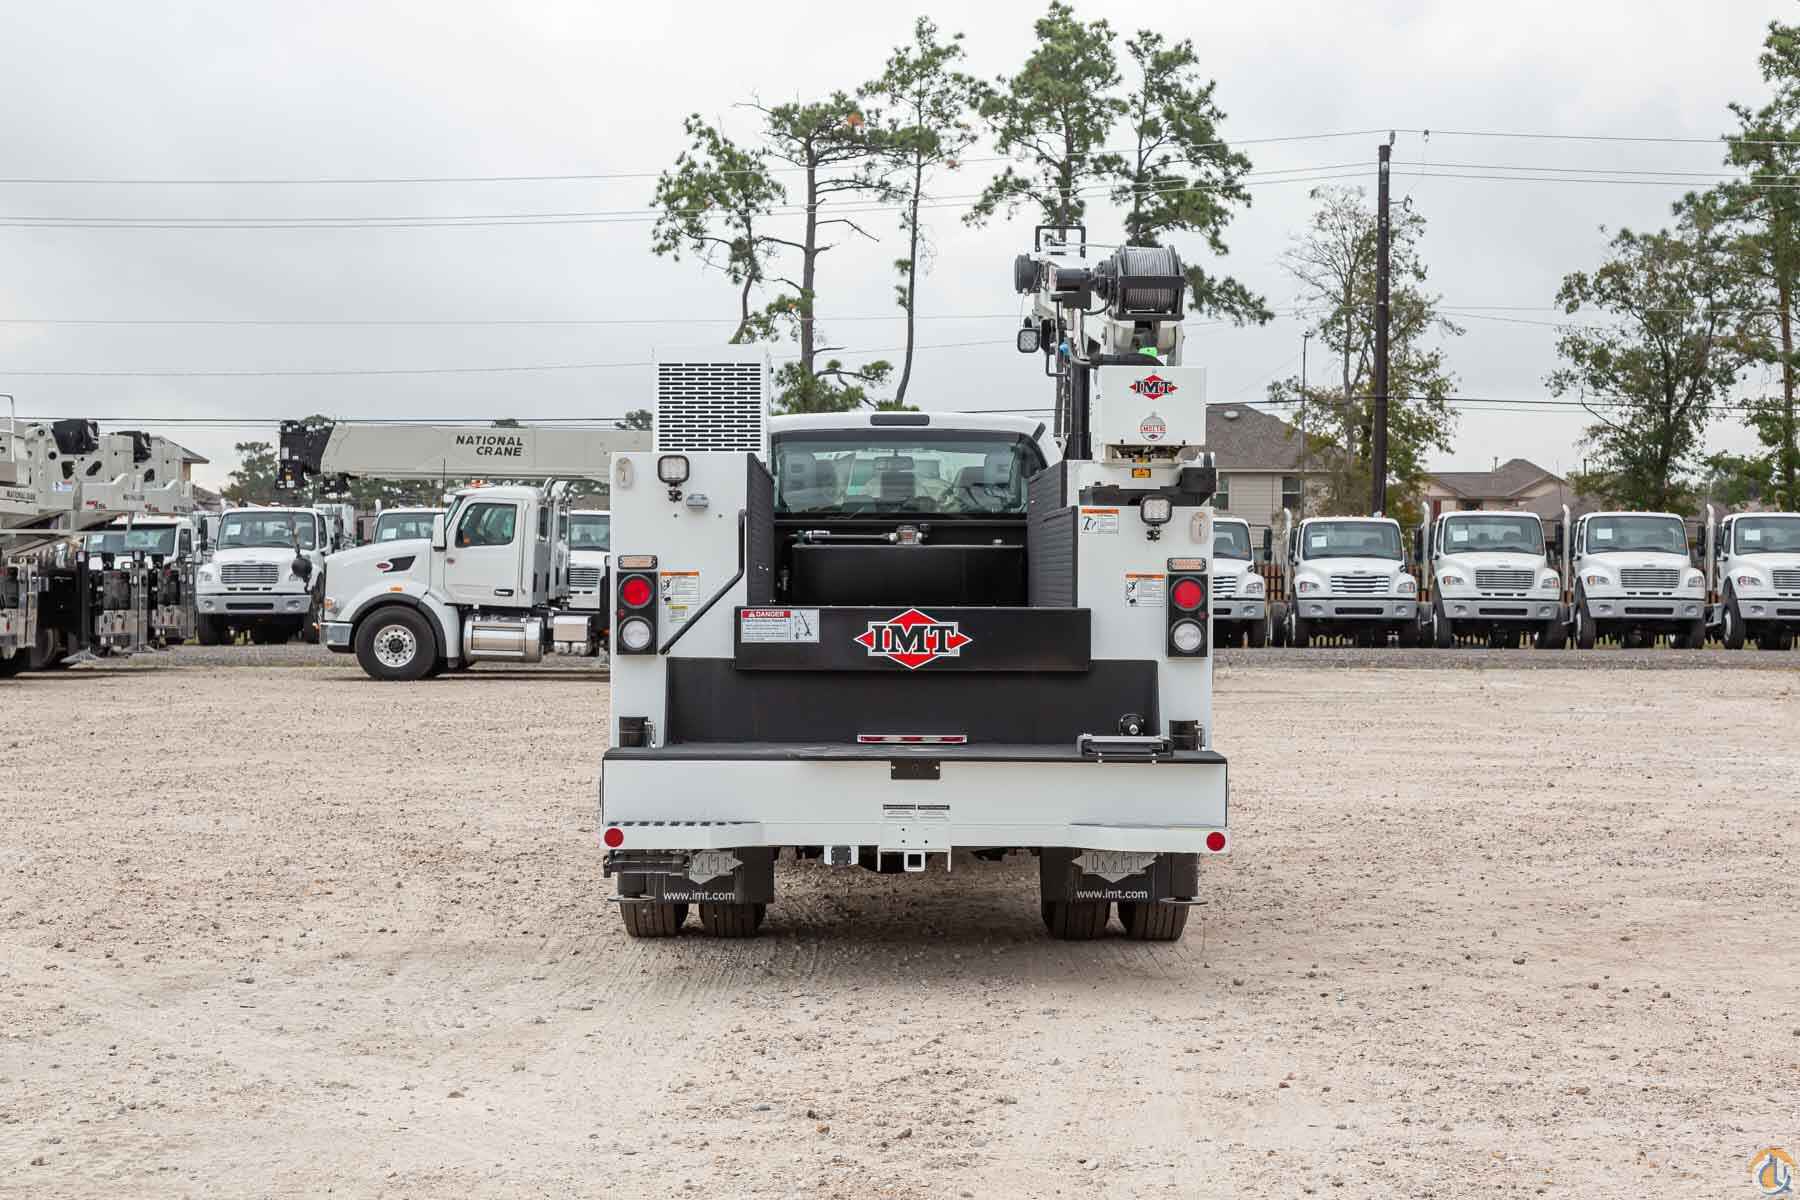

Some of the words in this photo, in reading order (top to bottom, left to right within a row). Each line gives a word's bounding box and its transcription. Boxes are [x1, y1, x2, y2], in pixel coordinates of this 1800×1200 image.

[1135, 381, 1172, 394] IMT
[456, 435, 524, 446] NATIONAL
[476, 446, 521, 456] CRANE
[870, 624, 955, 653] IMT
[664, 890, 735, 901] www.imt.com
[1076, 888, 1148, 899] www.imt.com
